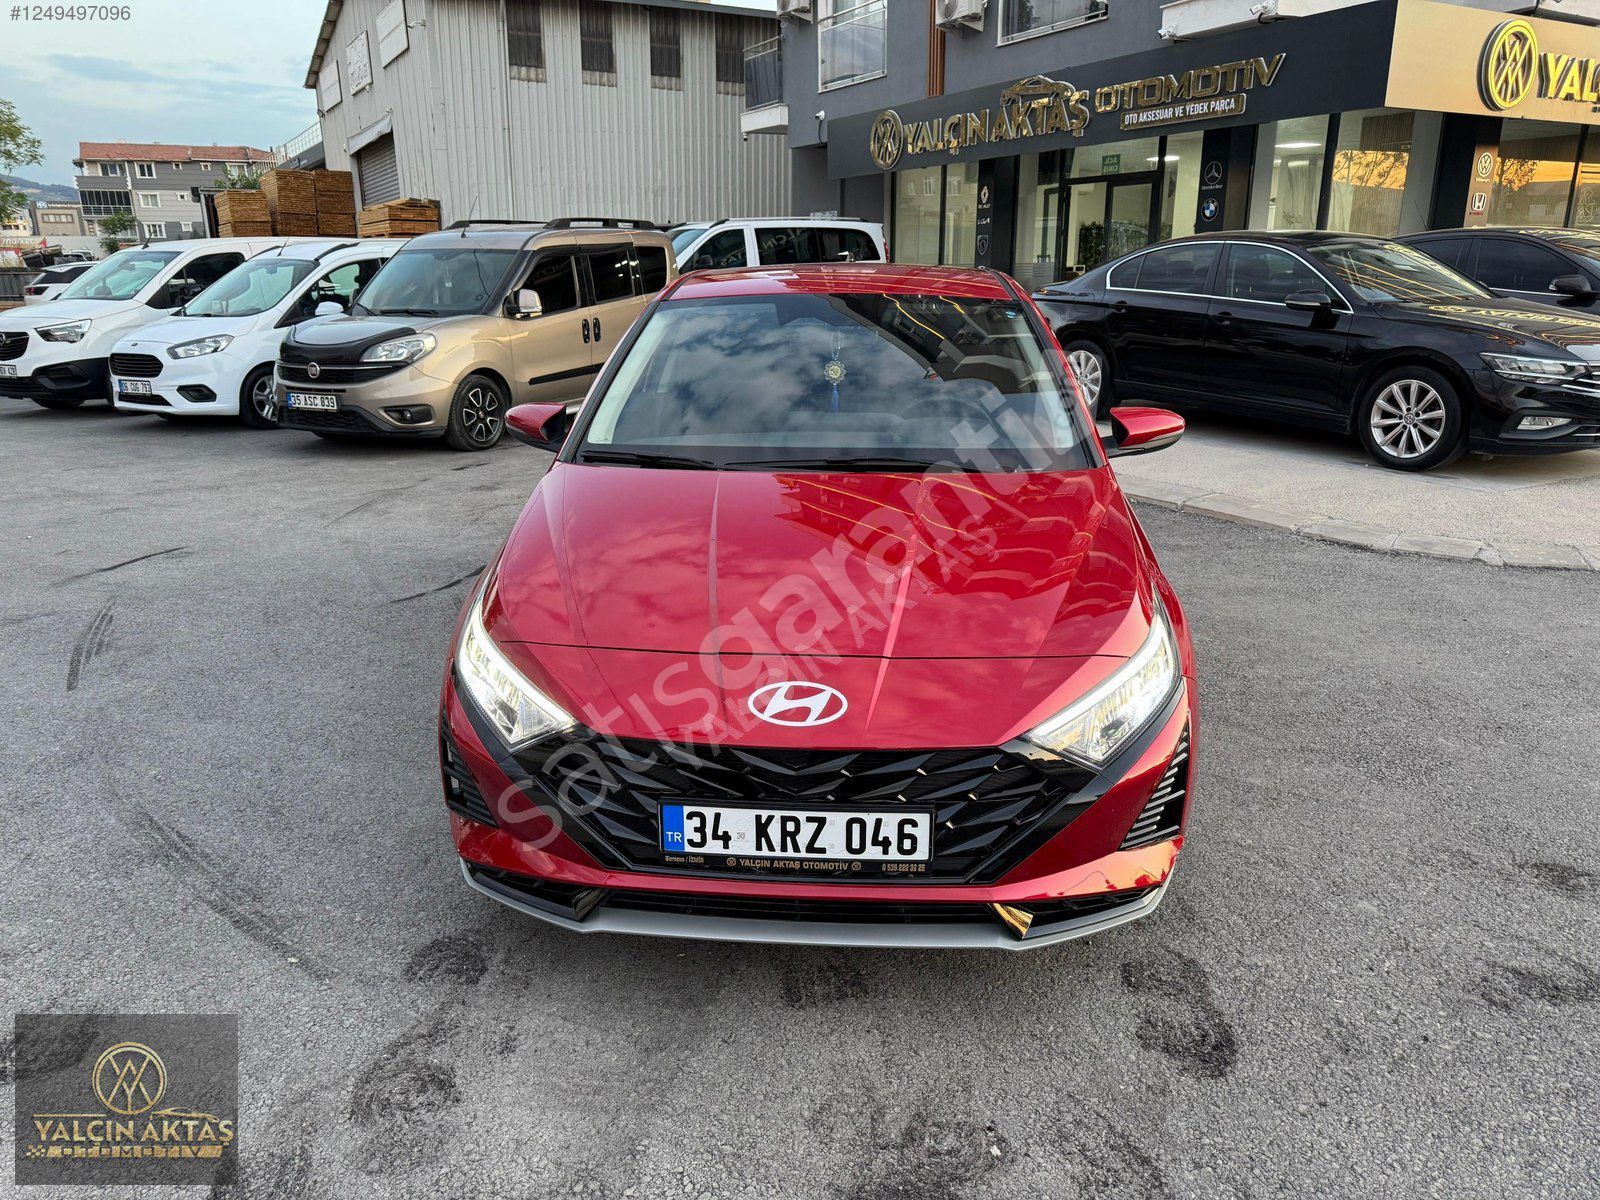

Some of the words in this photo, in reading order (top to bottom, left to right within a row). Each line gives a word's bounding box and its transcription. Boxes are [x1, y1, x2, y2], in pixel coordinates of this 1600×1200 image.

[1540, 52, 1600, 101] YAL
[904, 108, 990, 155] YALÇIN
[990, 89, 1090, 142] AKTAŞ
[1124, 114, 1138, 125] OTO
[1138, 105, 1173, 122] AKSESUAR
[1174, 106, 1184, 117] VE
[1185, 101, 1208, 116] YEDEK
[1210, 98, 1235, 112] PARÇA
[291, 394, 301, 406] 35
[304, 396, 318, 407] ASC
[320, 397, 335, 408] 839
[666, 832, 682, 843] TR
[686, 811, 732, 850] 34
[755, 814, 828, 855] KRZ
[845, 817, 919, 856] 046
[739, 858, 771, 868] YALÇIN
[773, 860, 801, 870] AKTAŞ
[802, 860, 849, 870] OTOMOTİV
